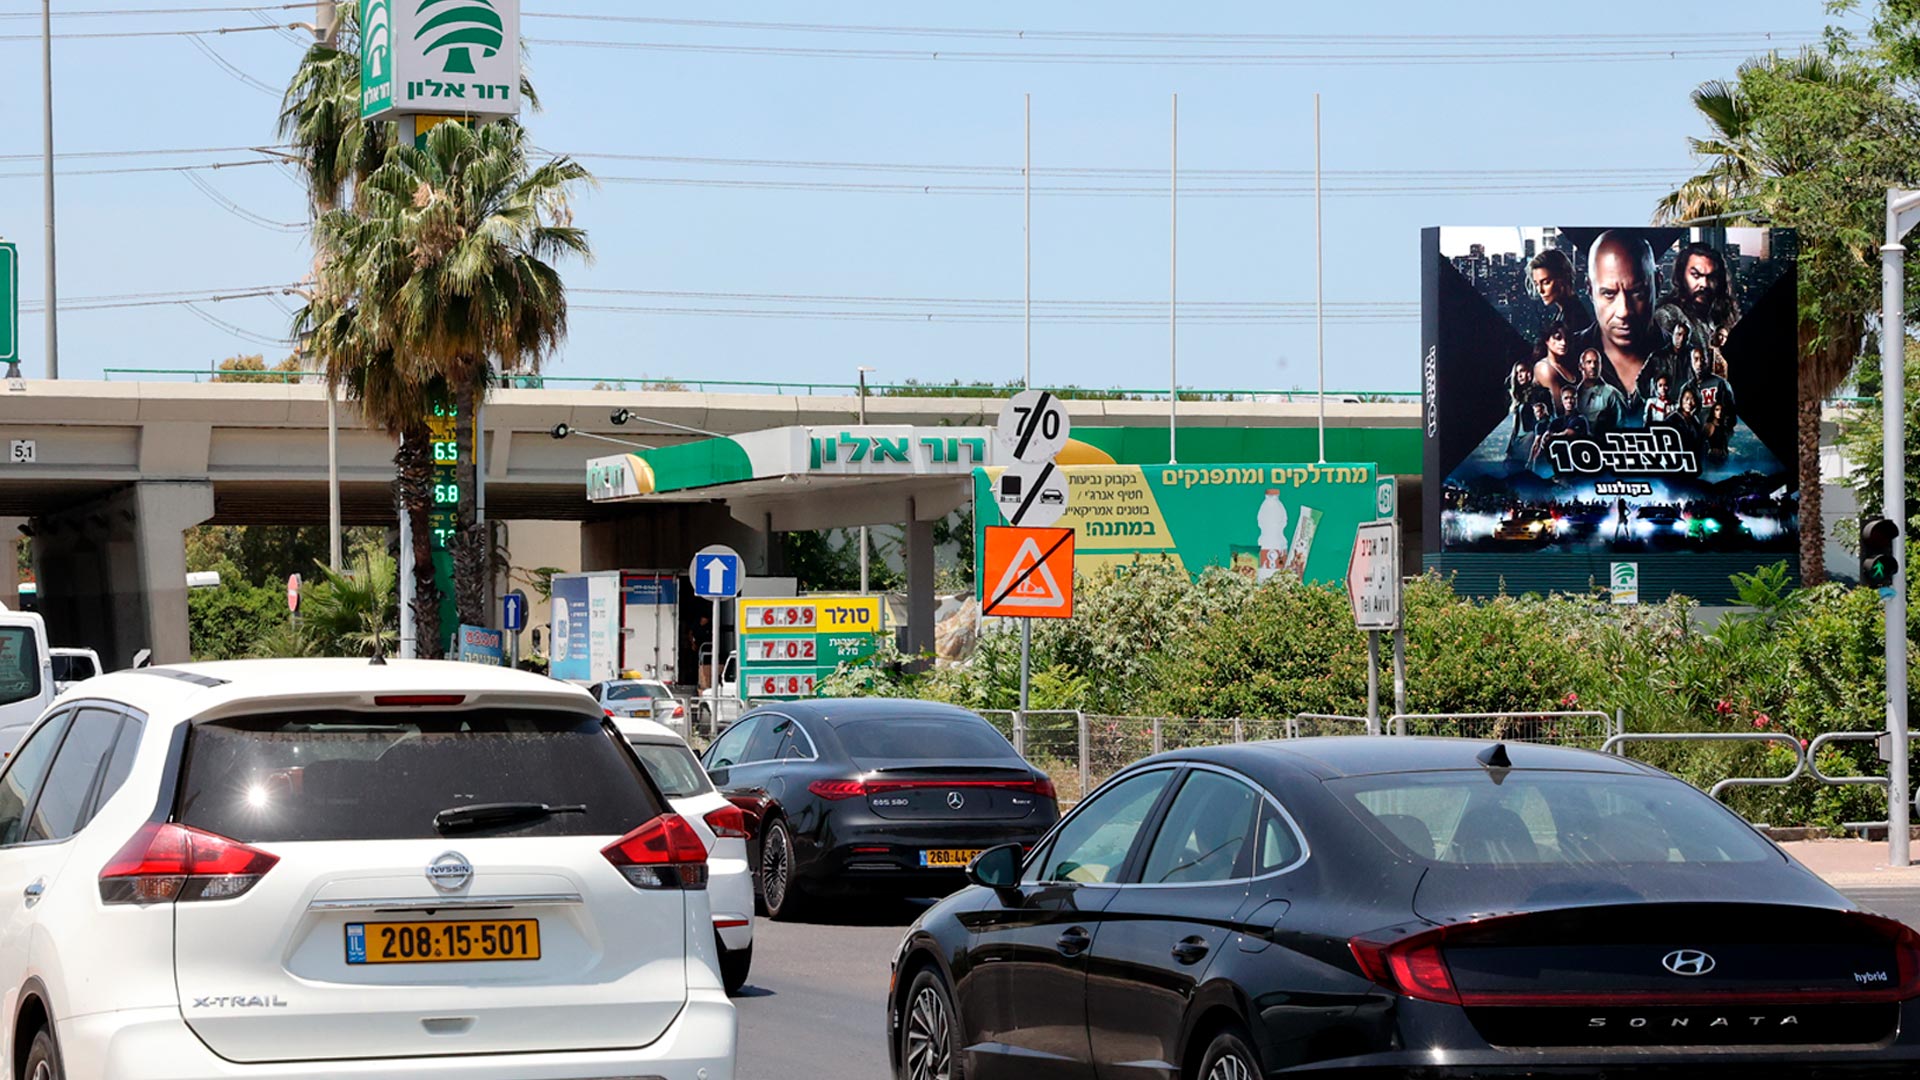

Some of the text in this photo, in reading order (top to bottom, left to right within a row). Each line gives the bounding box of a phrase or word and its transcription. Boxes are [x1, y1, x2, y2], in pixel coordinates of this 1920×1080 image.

[408, 79, 510, 100] דור אלון
[1013, 407, 1060, 440] 70
[1605, 426, 1683, 453] מהיר
[15, 445, 32, 458] 5.1
[810, 431, 986, 470] דור אלון
[1549, 440, 1698, 473] ועצבני 10
[1069, 475, 1137, 487] בקבוק נביעות
[1162, 464, 1368, 489] מתדלקים ומתפנקים
[1117, 490, 1143, 502] חטיף
[1596, 481, 1651, 495] בקולנוע
[1116, 506, 1150, 516] בוטנים
[1086, 521, 1156, 537] במתנה!
[1373, 595, 1390, 612] Aviv
[763, 608, 814, 625] 6.99
[825, 606, 870, 624] סולר
[763, 641, 814, 658] 7.02
[764, 676, 813, 694] 6.81
[350, 936, 362, 951] IL
[1853, 971, 1888, 984] hybrid
[192, 995, 288, 1008] X-TRAIL
[1588, 1015, 1799, 1028] SONATA
